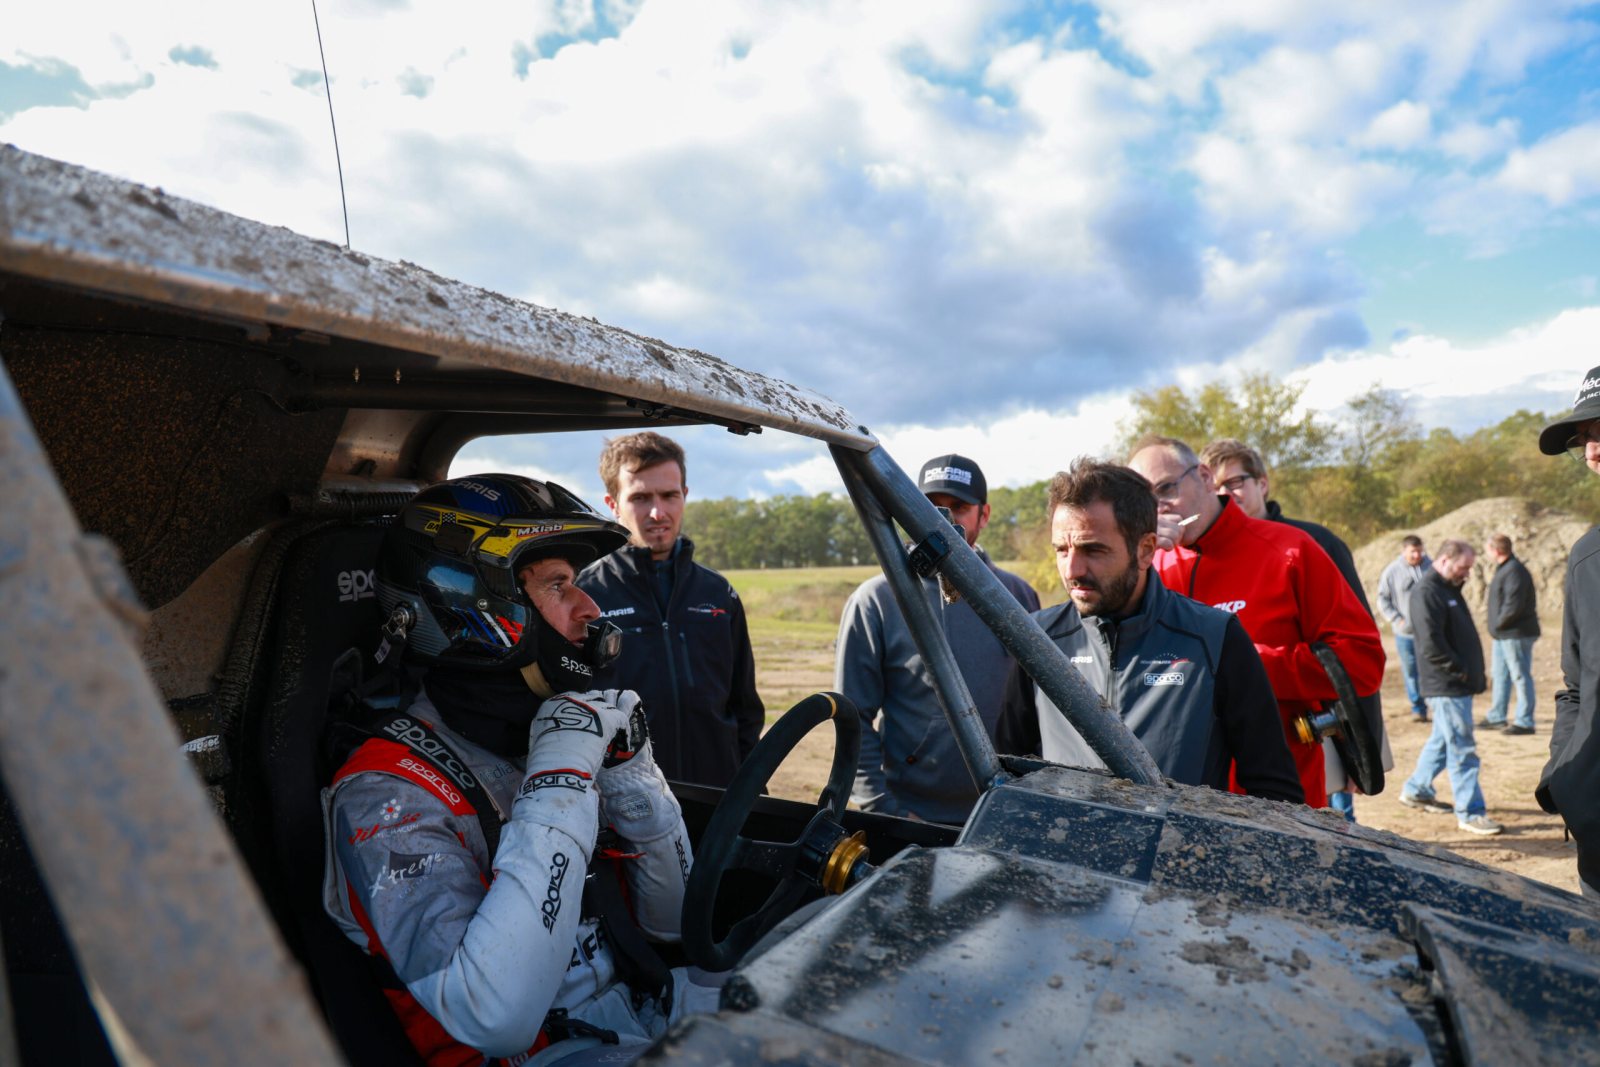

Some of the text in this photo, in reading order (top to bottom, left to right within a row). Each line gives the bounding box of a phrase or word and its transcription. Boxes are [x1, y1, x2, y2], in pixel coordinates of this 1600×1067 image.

[925, 467, 972, 479] POLARIS
[517, 524, 563, 537] MXlab
[337, 570, 374, 601] sp
[600, 607, 635, 617] LARIS
[1145, 674, 1183, 685] sparco
[384, 718, 475, 789] sparco
[396, 759, 460, 806] sparco
[541, 852, 570, 935] sparco
